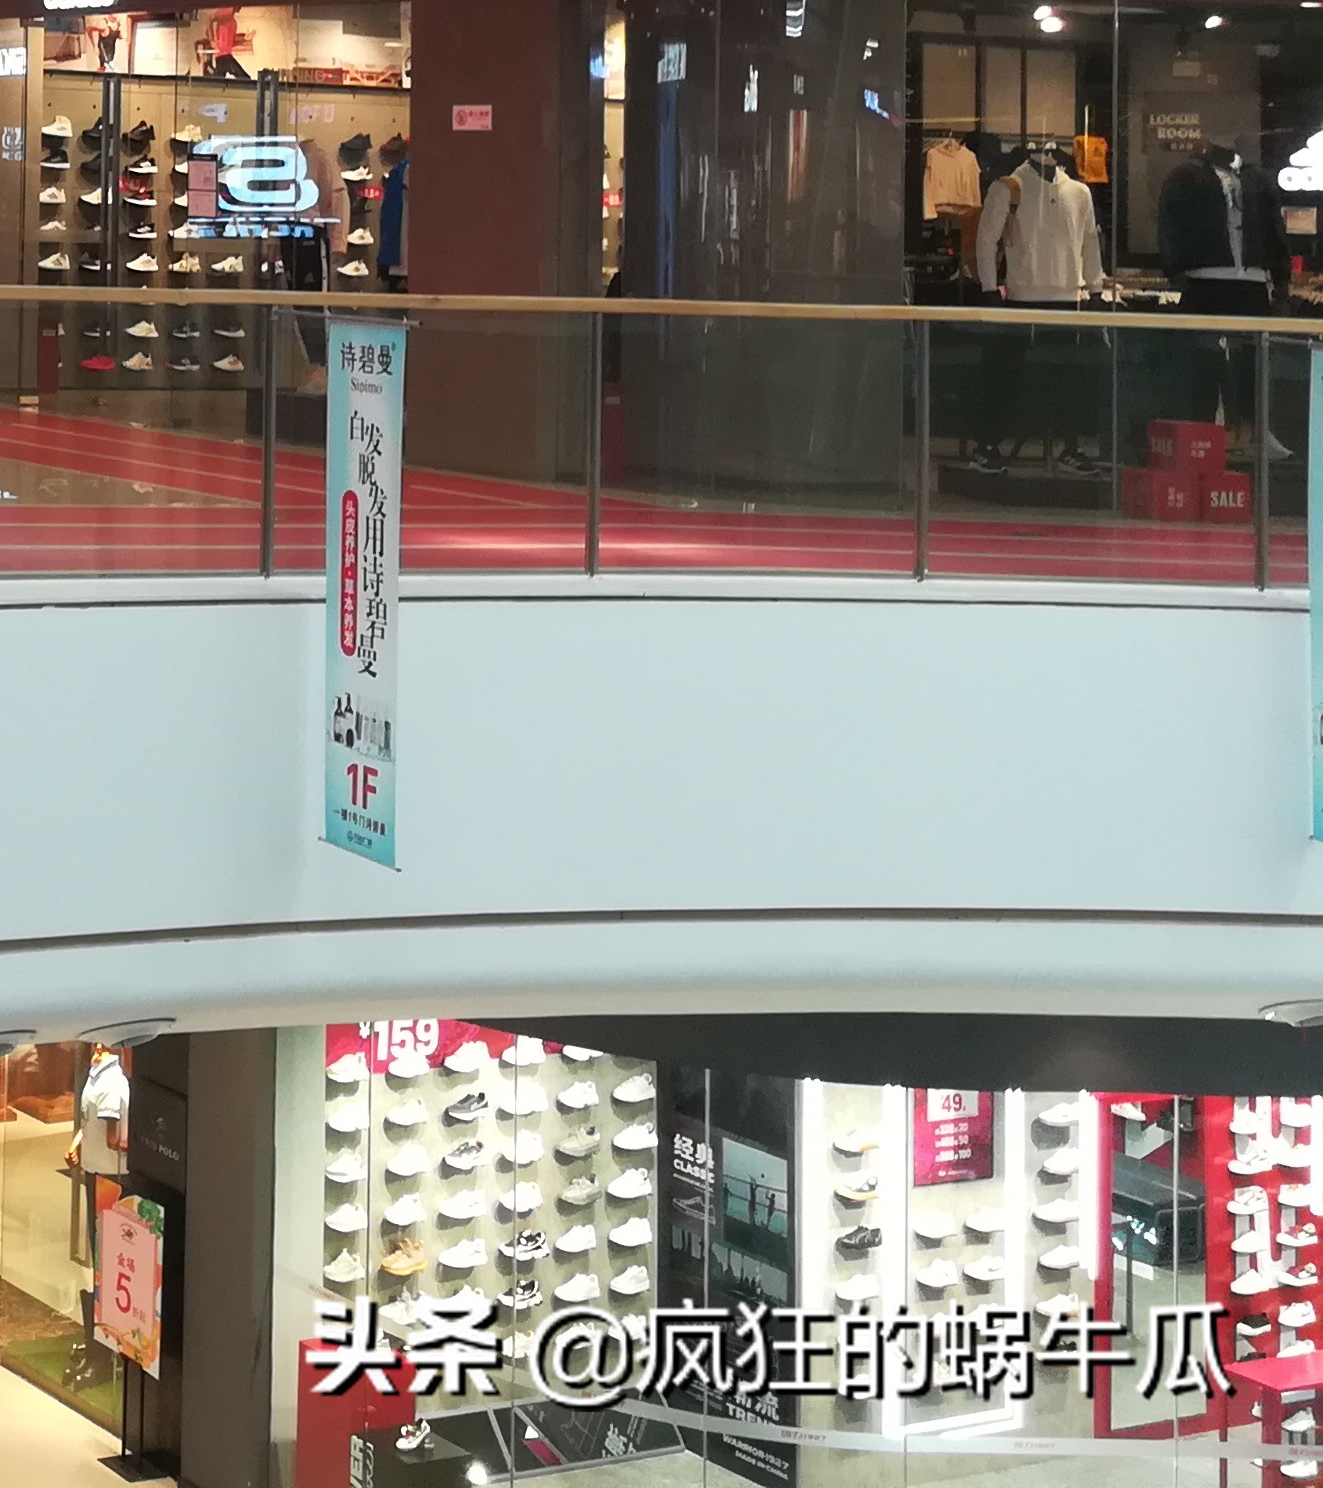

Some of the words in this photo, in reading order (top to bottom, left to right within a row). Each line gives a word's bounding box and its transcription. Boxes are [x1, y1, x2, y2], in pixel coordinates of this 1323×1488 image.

[1149, 113, 1200, 125] LOCKER
[1157, 127, 1202, 139] ROOM
[340, 341, 393, 376] 诗碧曼
[350, 377, 383, 396] Sipimo
[1210, 491, 1244, 508] SALE
[350, 410, 387, 678] 白发脱发用诗碧曼
[346, 763, 378, 810] 1F
[115, 1272, 132, 1313] 5
[726, 1402, 777, 1427] TREN
